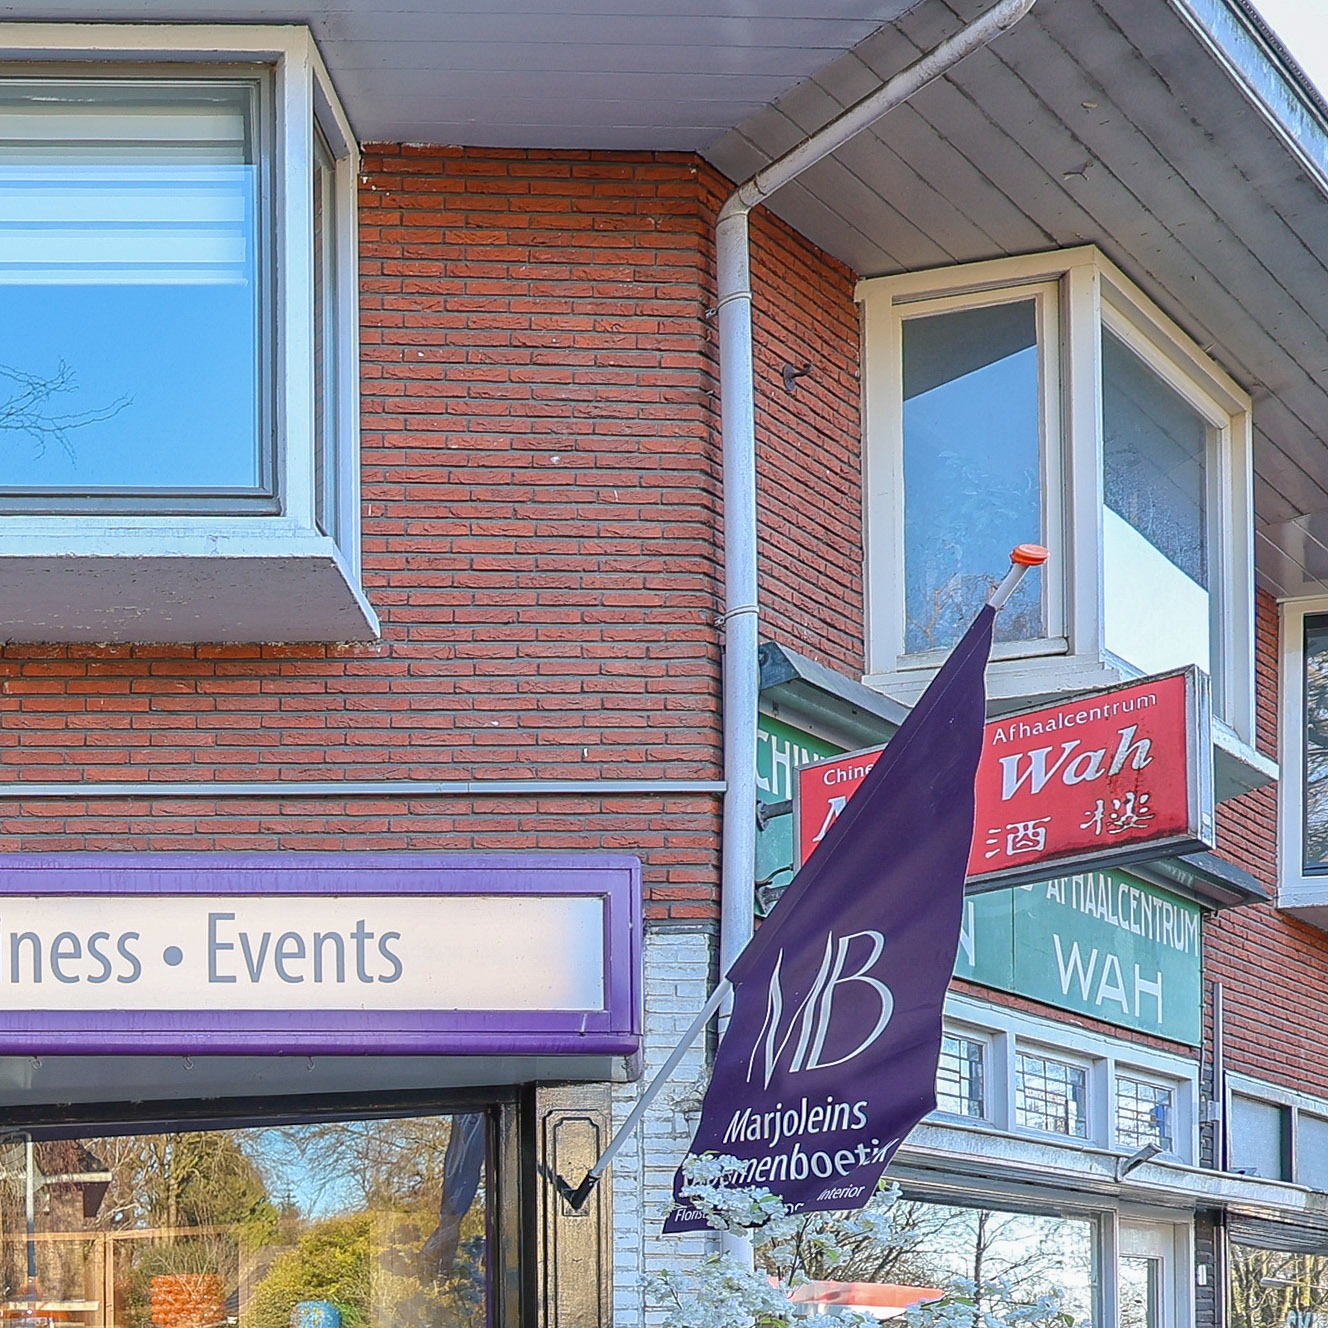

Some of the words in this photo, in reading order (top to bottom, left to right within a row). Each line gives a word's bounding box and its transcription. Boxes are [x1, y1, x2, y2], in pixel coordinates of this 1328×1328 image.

[992, 693, 1157, 746] Afhaalcentrum
[998, 723, 1154, 802] Wah
[207, 911, 404, 984] Events
[1052, 933, 1163, 1025] WAH
[746, 930, 896, 1091] MB
[722, 1095, 870, 1149] Marjoleins
[816, 1182, 866, 1202] Interior
